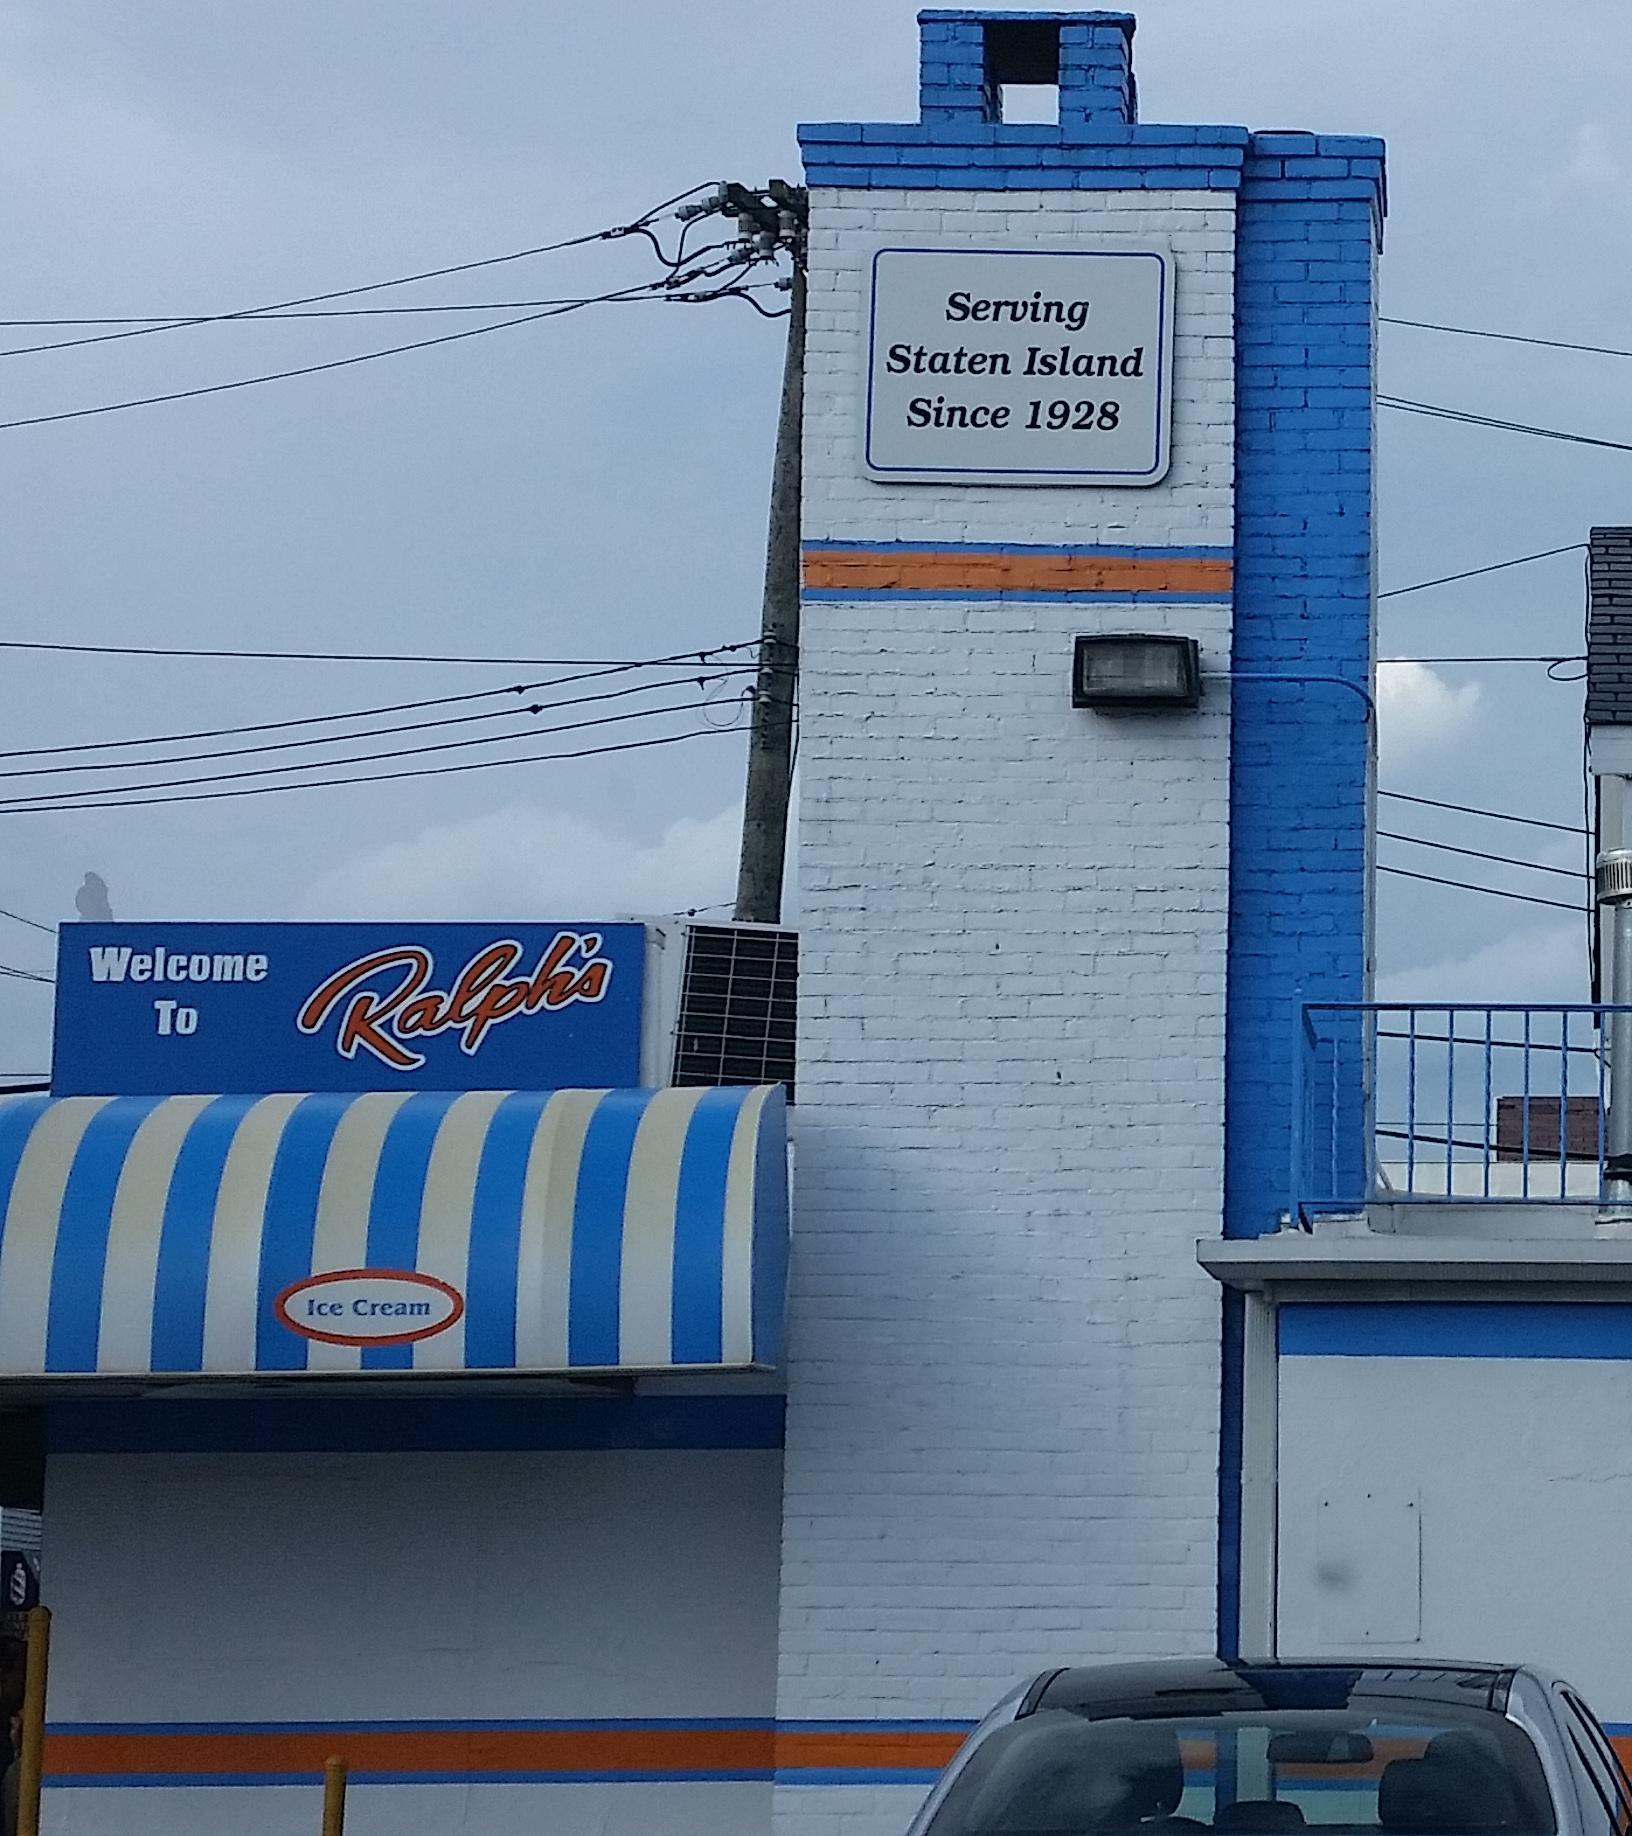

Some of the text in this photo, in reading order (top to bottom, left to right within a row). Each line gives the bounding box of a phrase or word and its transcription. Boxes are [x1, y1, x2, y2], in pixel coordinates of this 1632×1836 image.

[946, 291, 1089, 331] Serving
[886, 344, 1144, 377] Staten Island
[906, 396, 1120, 430] Since 1928
[90, 947, 269, 982] Welcome
[154, 1000, 199, 1035] To
[300, 933, 610, 1067] Ralph's
[307, 1299, 430, 1316] Ice Cream
